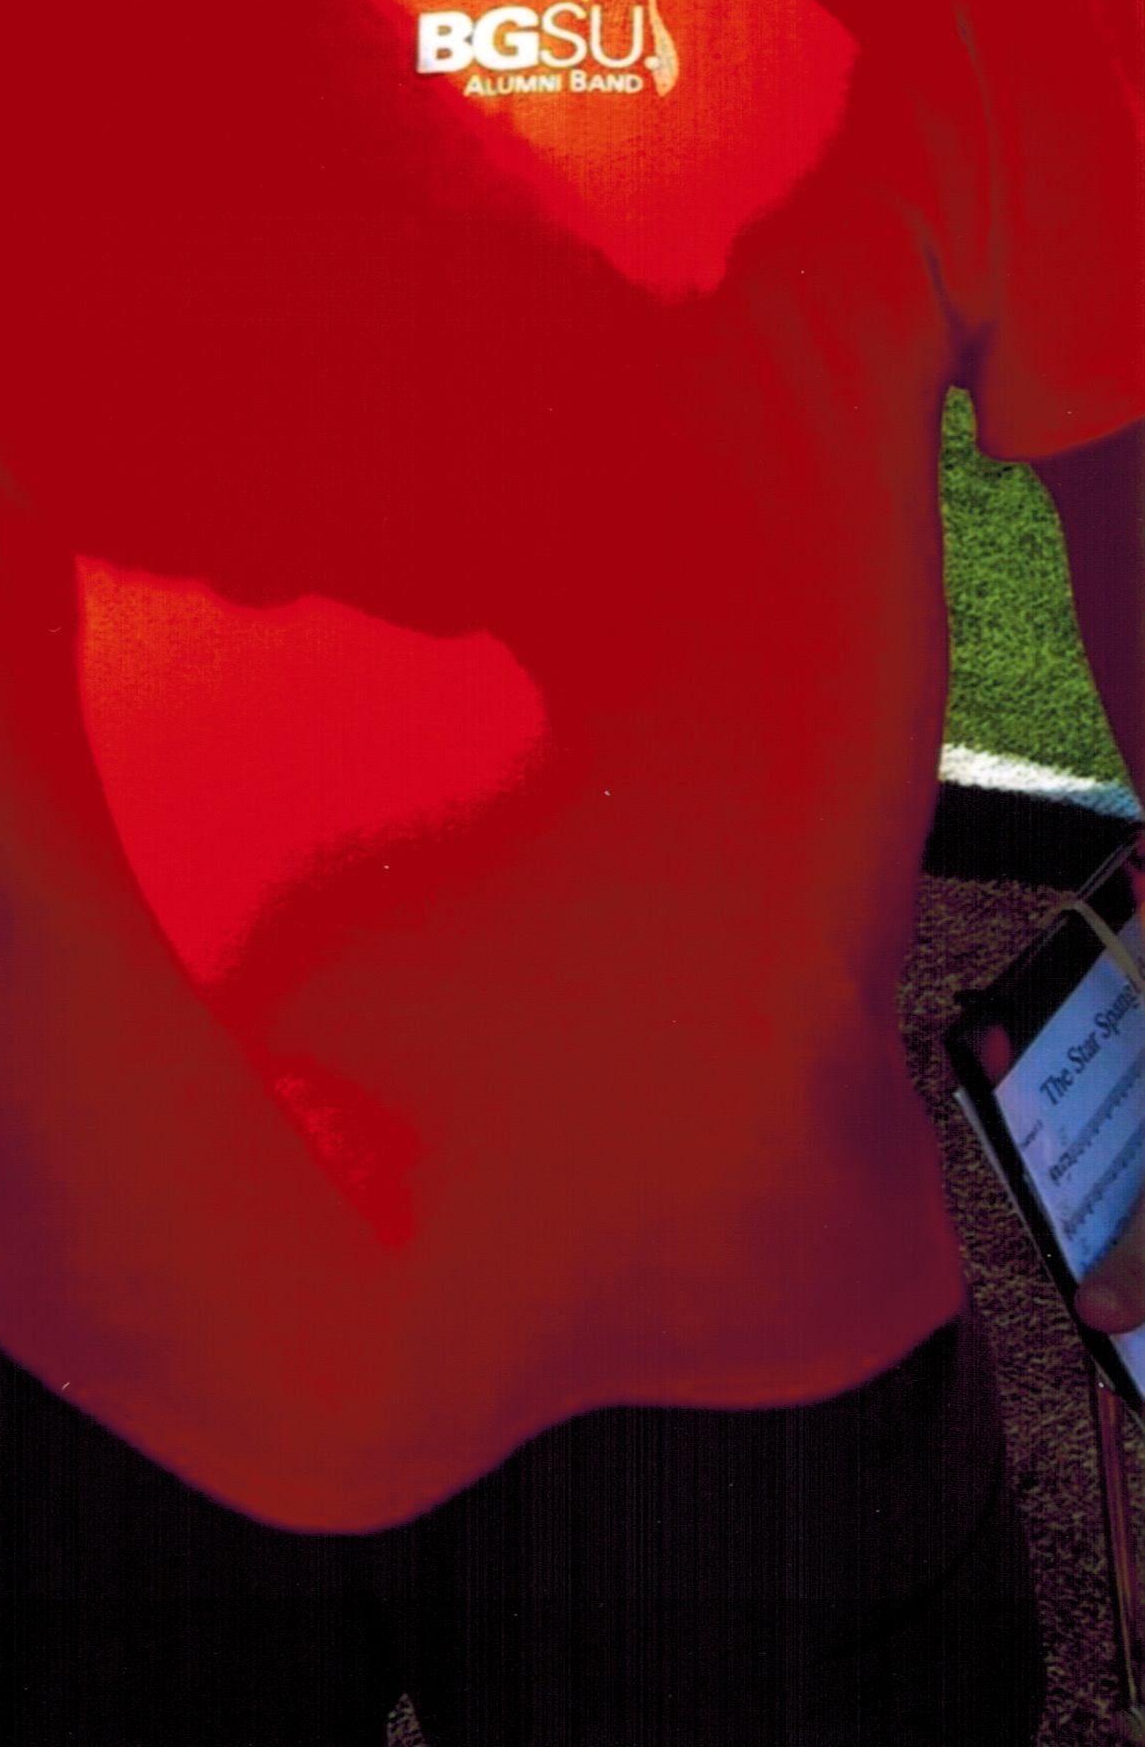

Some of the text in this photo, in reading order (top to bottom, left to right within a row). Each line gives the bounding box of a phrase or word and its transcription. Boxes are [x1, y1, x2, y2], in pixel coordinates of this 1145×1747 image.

[416, 1, 644, 74] BGSU
[463, 68, 644, 97] ALUMNI BAND
[1040, 1067, 1074, 1106] The
[1067, 1029, 1101, 1075] Star
